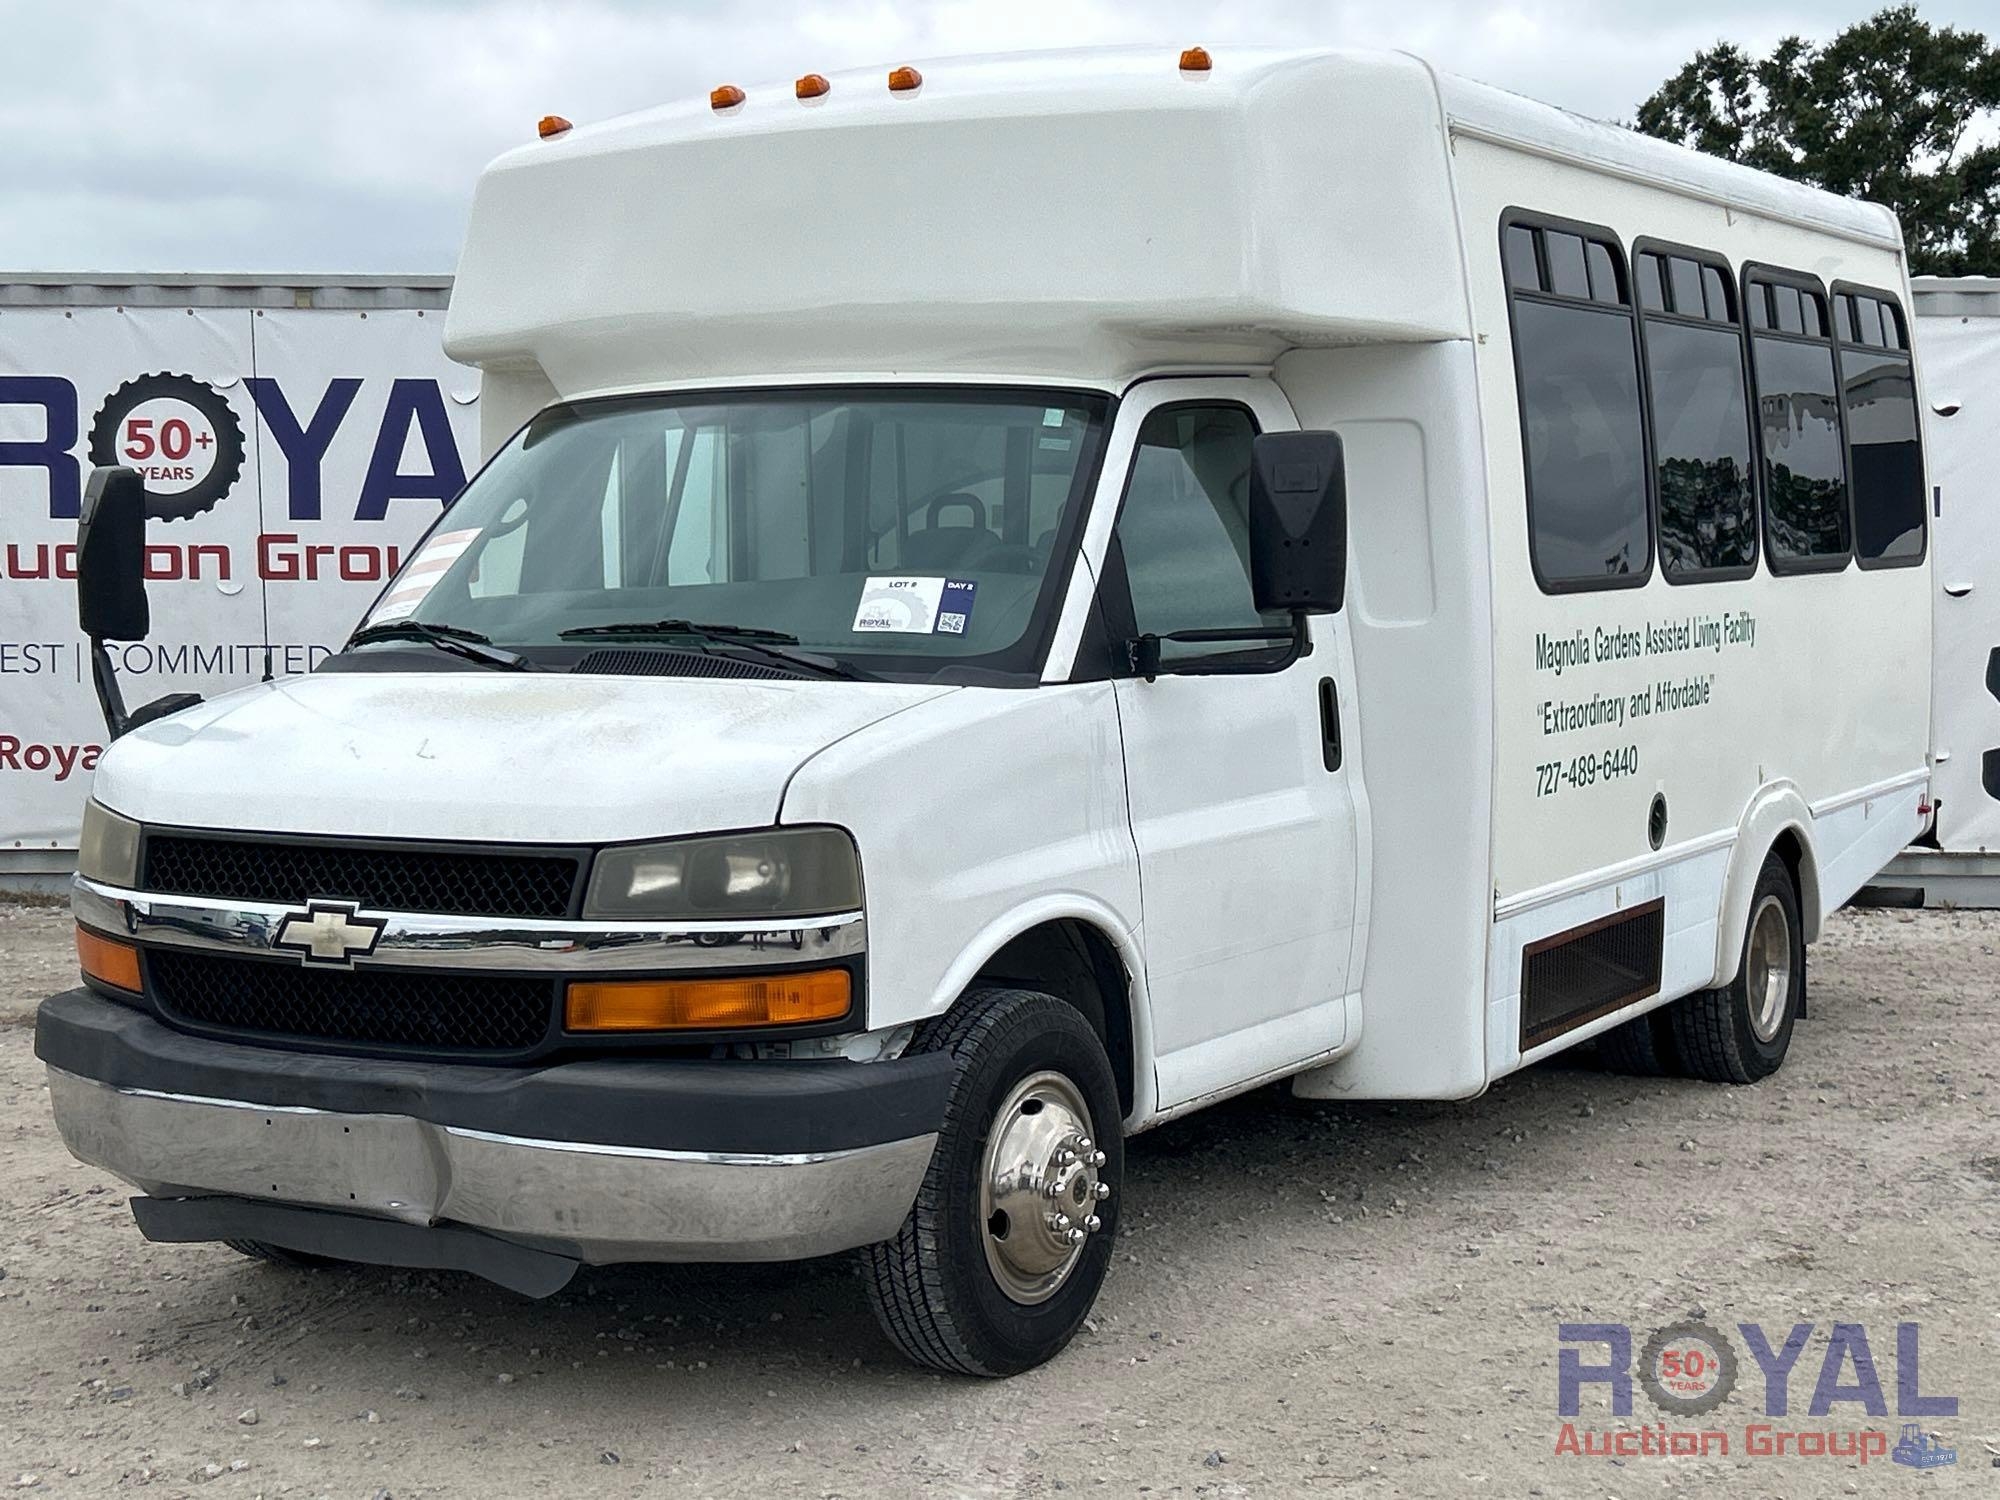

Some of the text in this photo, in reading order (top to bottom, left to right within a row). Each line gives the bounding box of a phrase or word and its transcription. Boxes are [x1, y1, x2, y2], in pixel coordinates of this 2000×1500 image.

[124, 419, 214, 461] 50+
[139, 466, 195, 482] YEARS
[947, 582, 966, 590] DAY
[1535, 611, 1756, 676] Magnolia Gardens Assisted Living Facility
[1630, 684, 1651, 718] and
[1535, 745, 1638, 797] 727-489-6440
